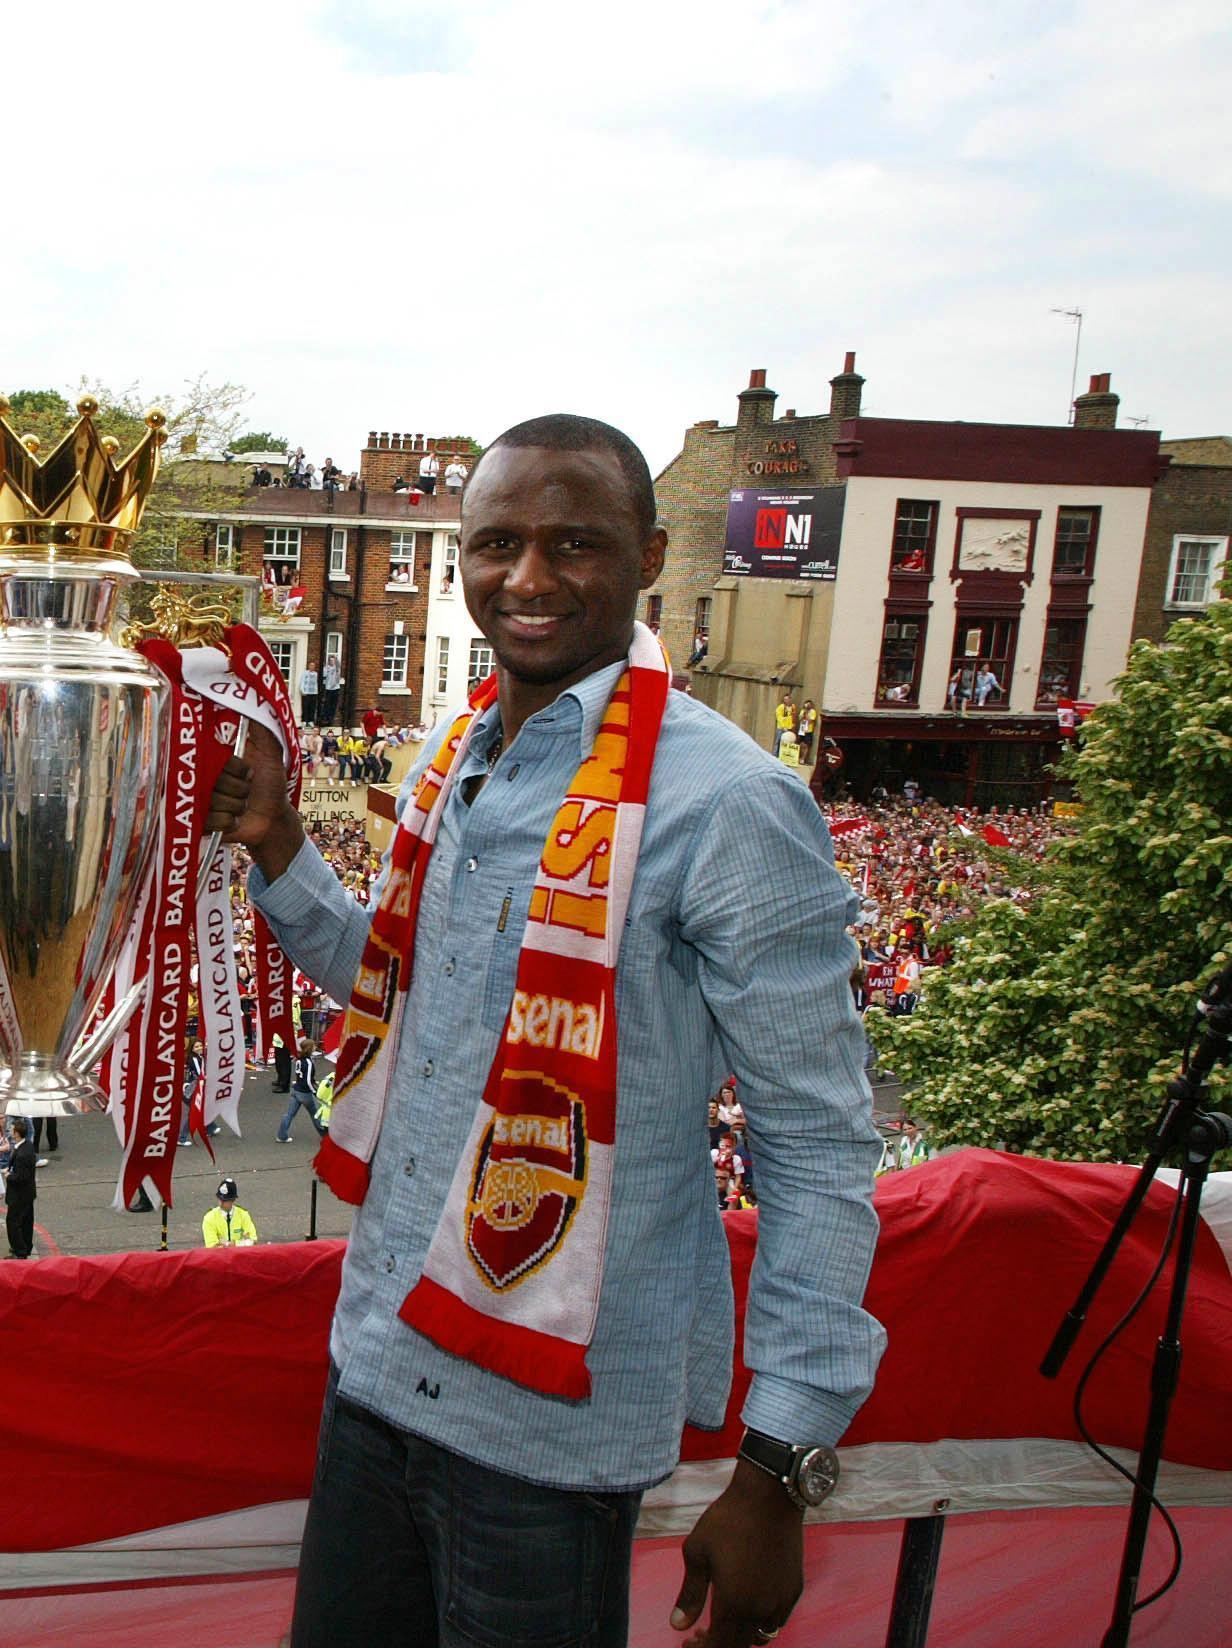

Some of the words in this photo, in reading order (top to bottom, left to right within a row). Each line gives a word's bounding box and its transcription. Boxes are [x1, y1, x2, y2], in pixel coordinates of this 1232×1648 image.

[165, 702, 197, 927] BARCLAYCARD
[302, 790, 350, 803] SUTTON
[144, 943, 182, 1158] BARCLAYCARD
[208, 908, 235, 1102] BARCLAYCARD
